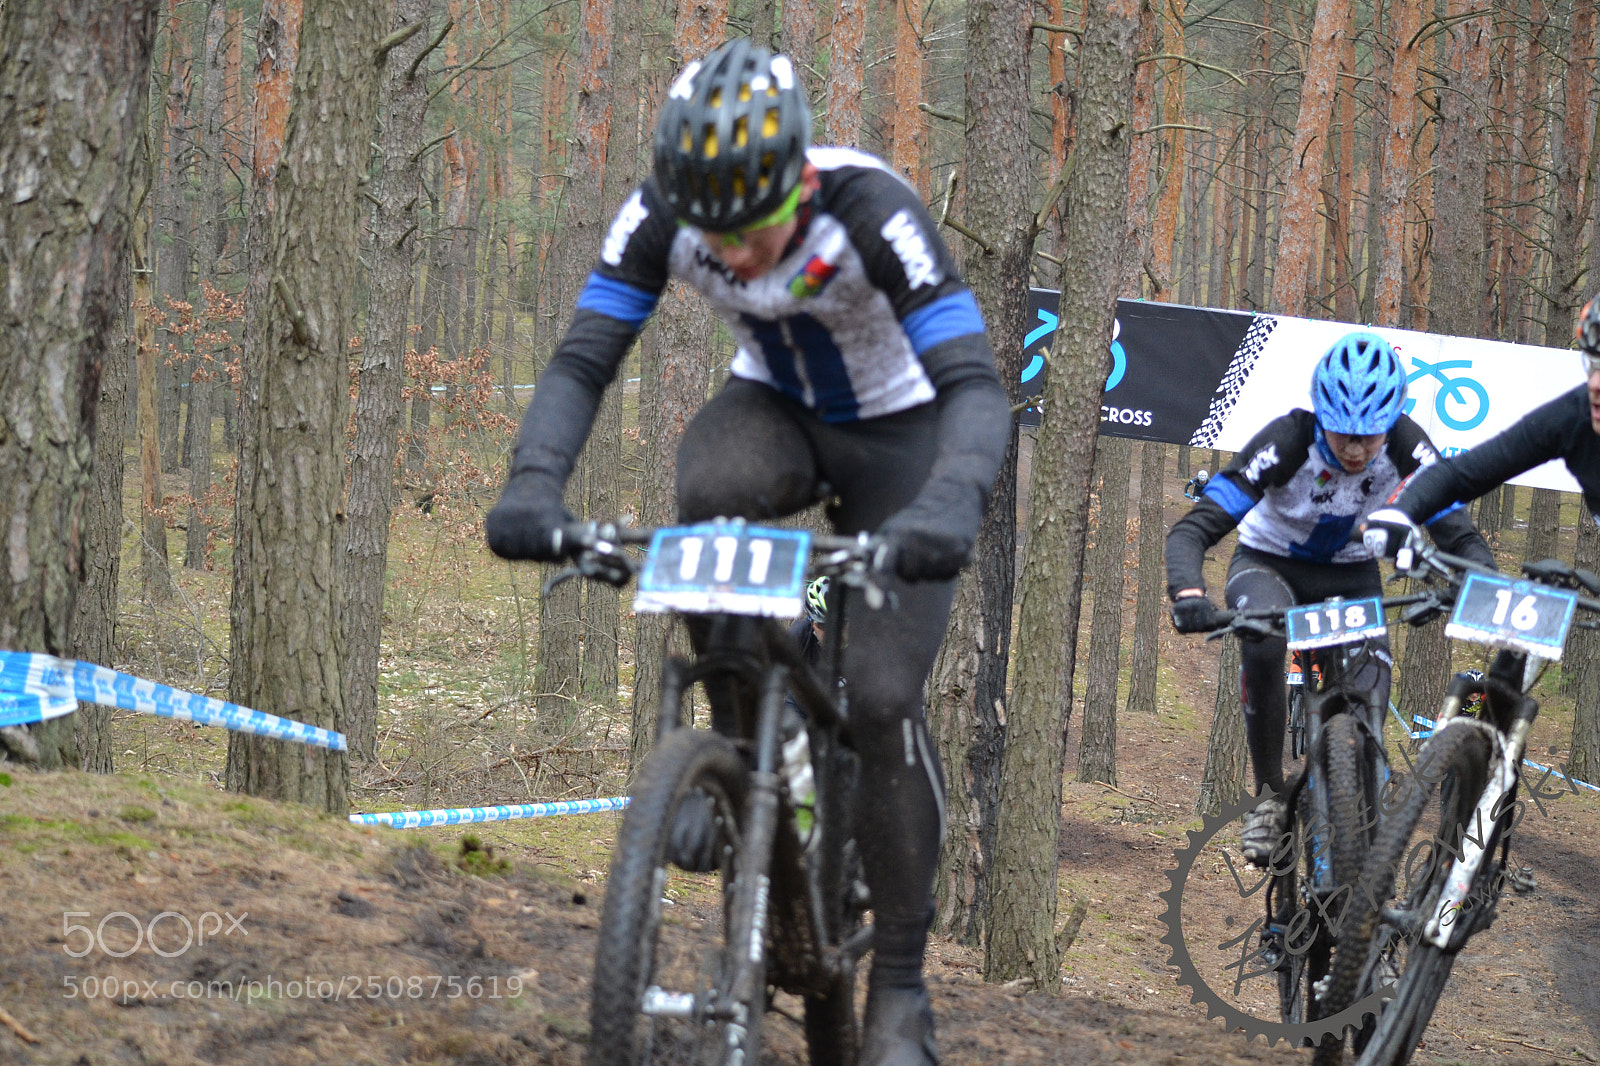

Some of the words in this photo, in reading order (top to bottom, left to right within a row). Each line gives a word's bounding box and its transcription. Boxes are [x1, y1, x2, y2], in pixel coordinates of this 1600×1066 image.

[679, 536, 773, 585] 111
[1304, 605, 1367, 635] 118
[1492, 589, 1538, 631] 16
